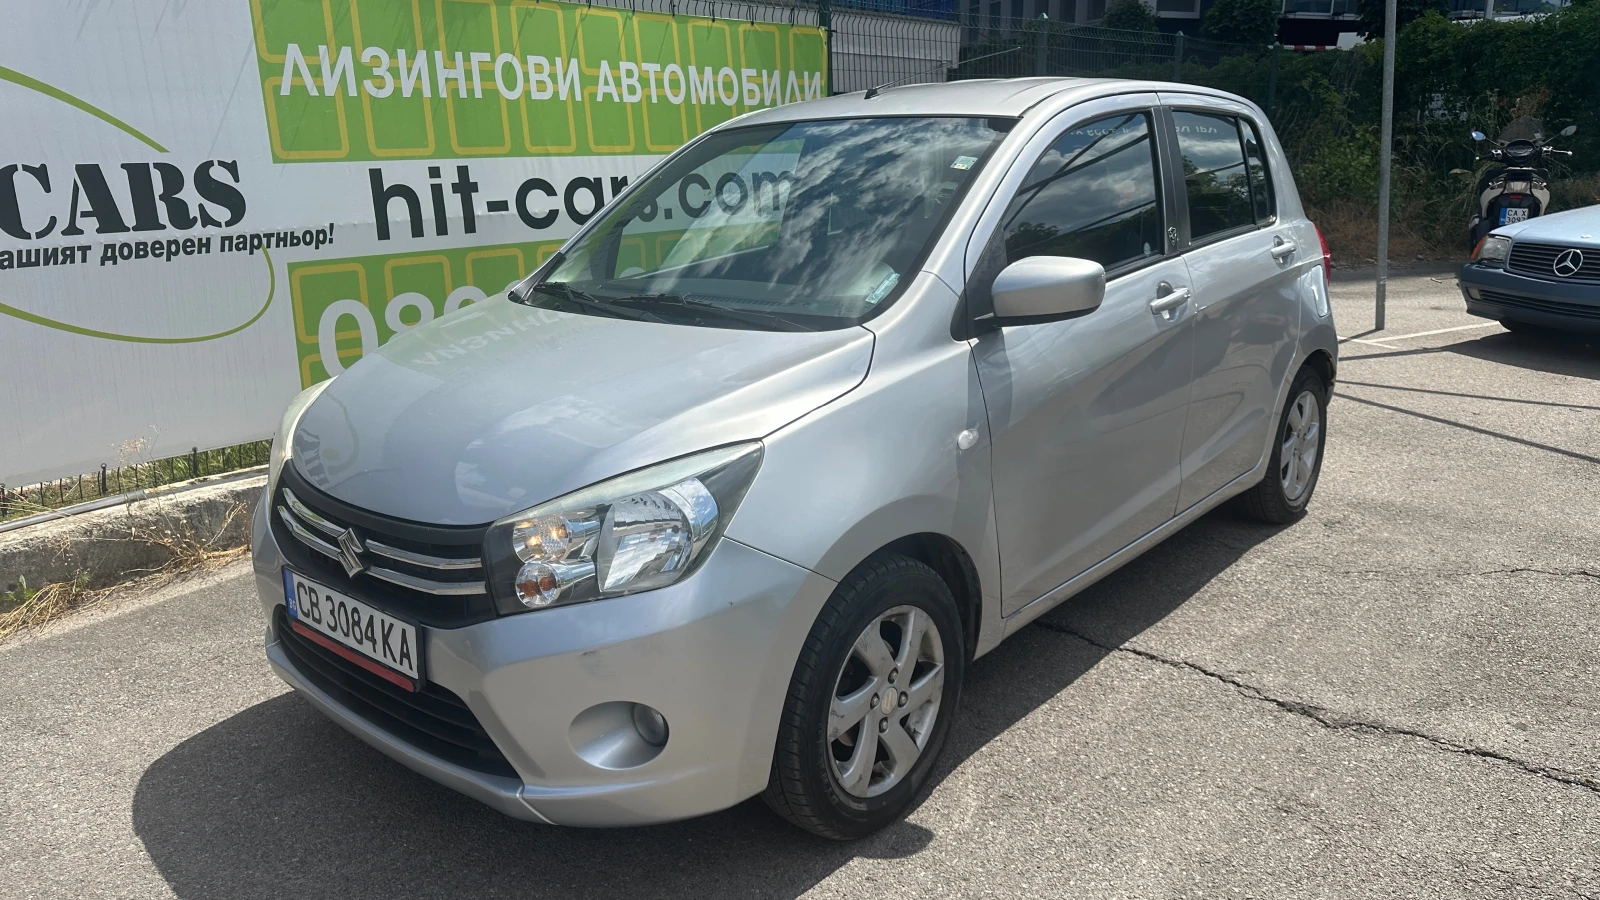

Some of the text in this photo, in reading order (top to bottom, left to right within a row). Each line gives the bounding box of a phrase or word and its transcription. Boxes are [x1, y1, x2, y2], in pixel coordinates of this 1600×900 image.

[280, 43, 821, 106] ЛИЗИНГОВИ АВТОМОБИЛИ
[0, 160, 246, 240] CARS
[100, 237, 211, 266] доверен
[220, 223, 334, 255] партньор!
[296, 581, 413, 671] CB 3084 KA
